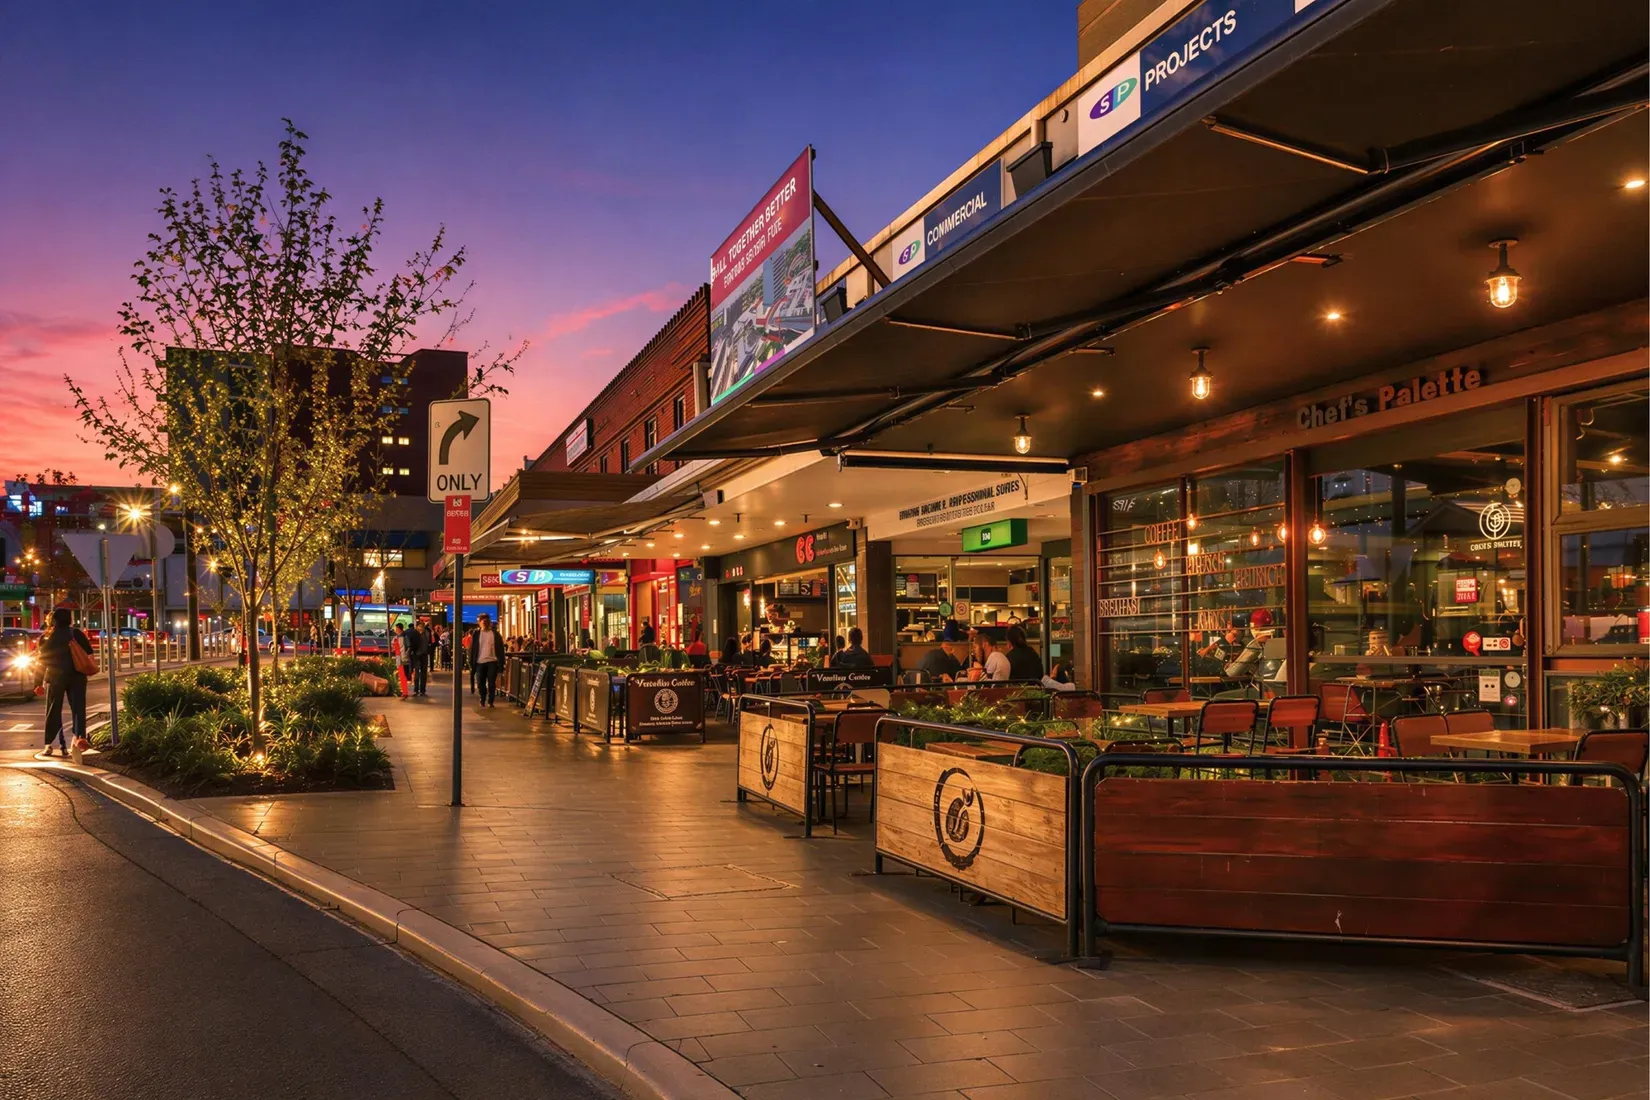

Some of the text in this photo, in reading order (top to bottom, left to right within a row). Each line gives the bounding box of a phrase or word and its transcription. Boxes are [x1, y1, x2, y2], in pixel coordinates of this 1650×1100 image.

[1145, 9, 1237, 91] PROJECTS
[728, 214, 765, 263] TOGETHER
[765, 177, 796, 222] BETTER
[1297, 366, 1481, 430] Chef's Palette
[436, 473, 482, 491] ONLY
